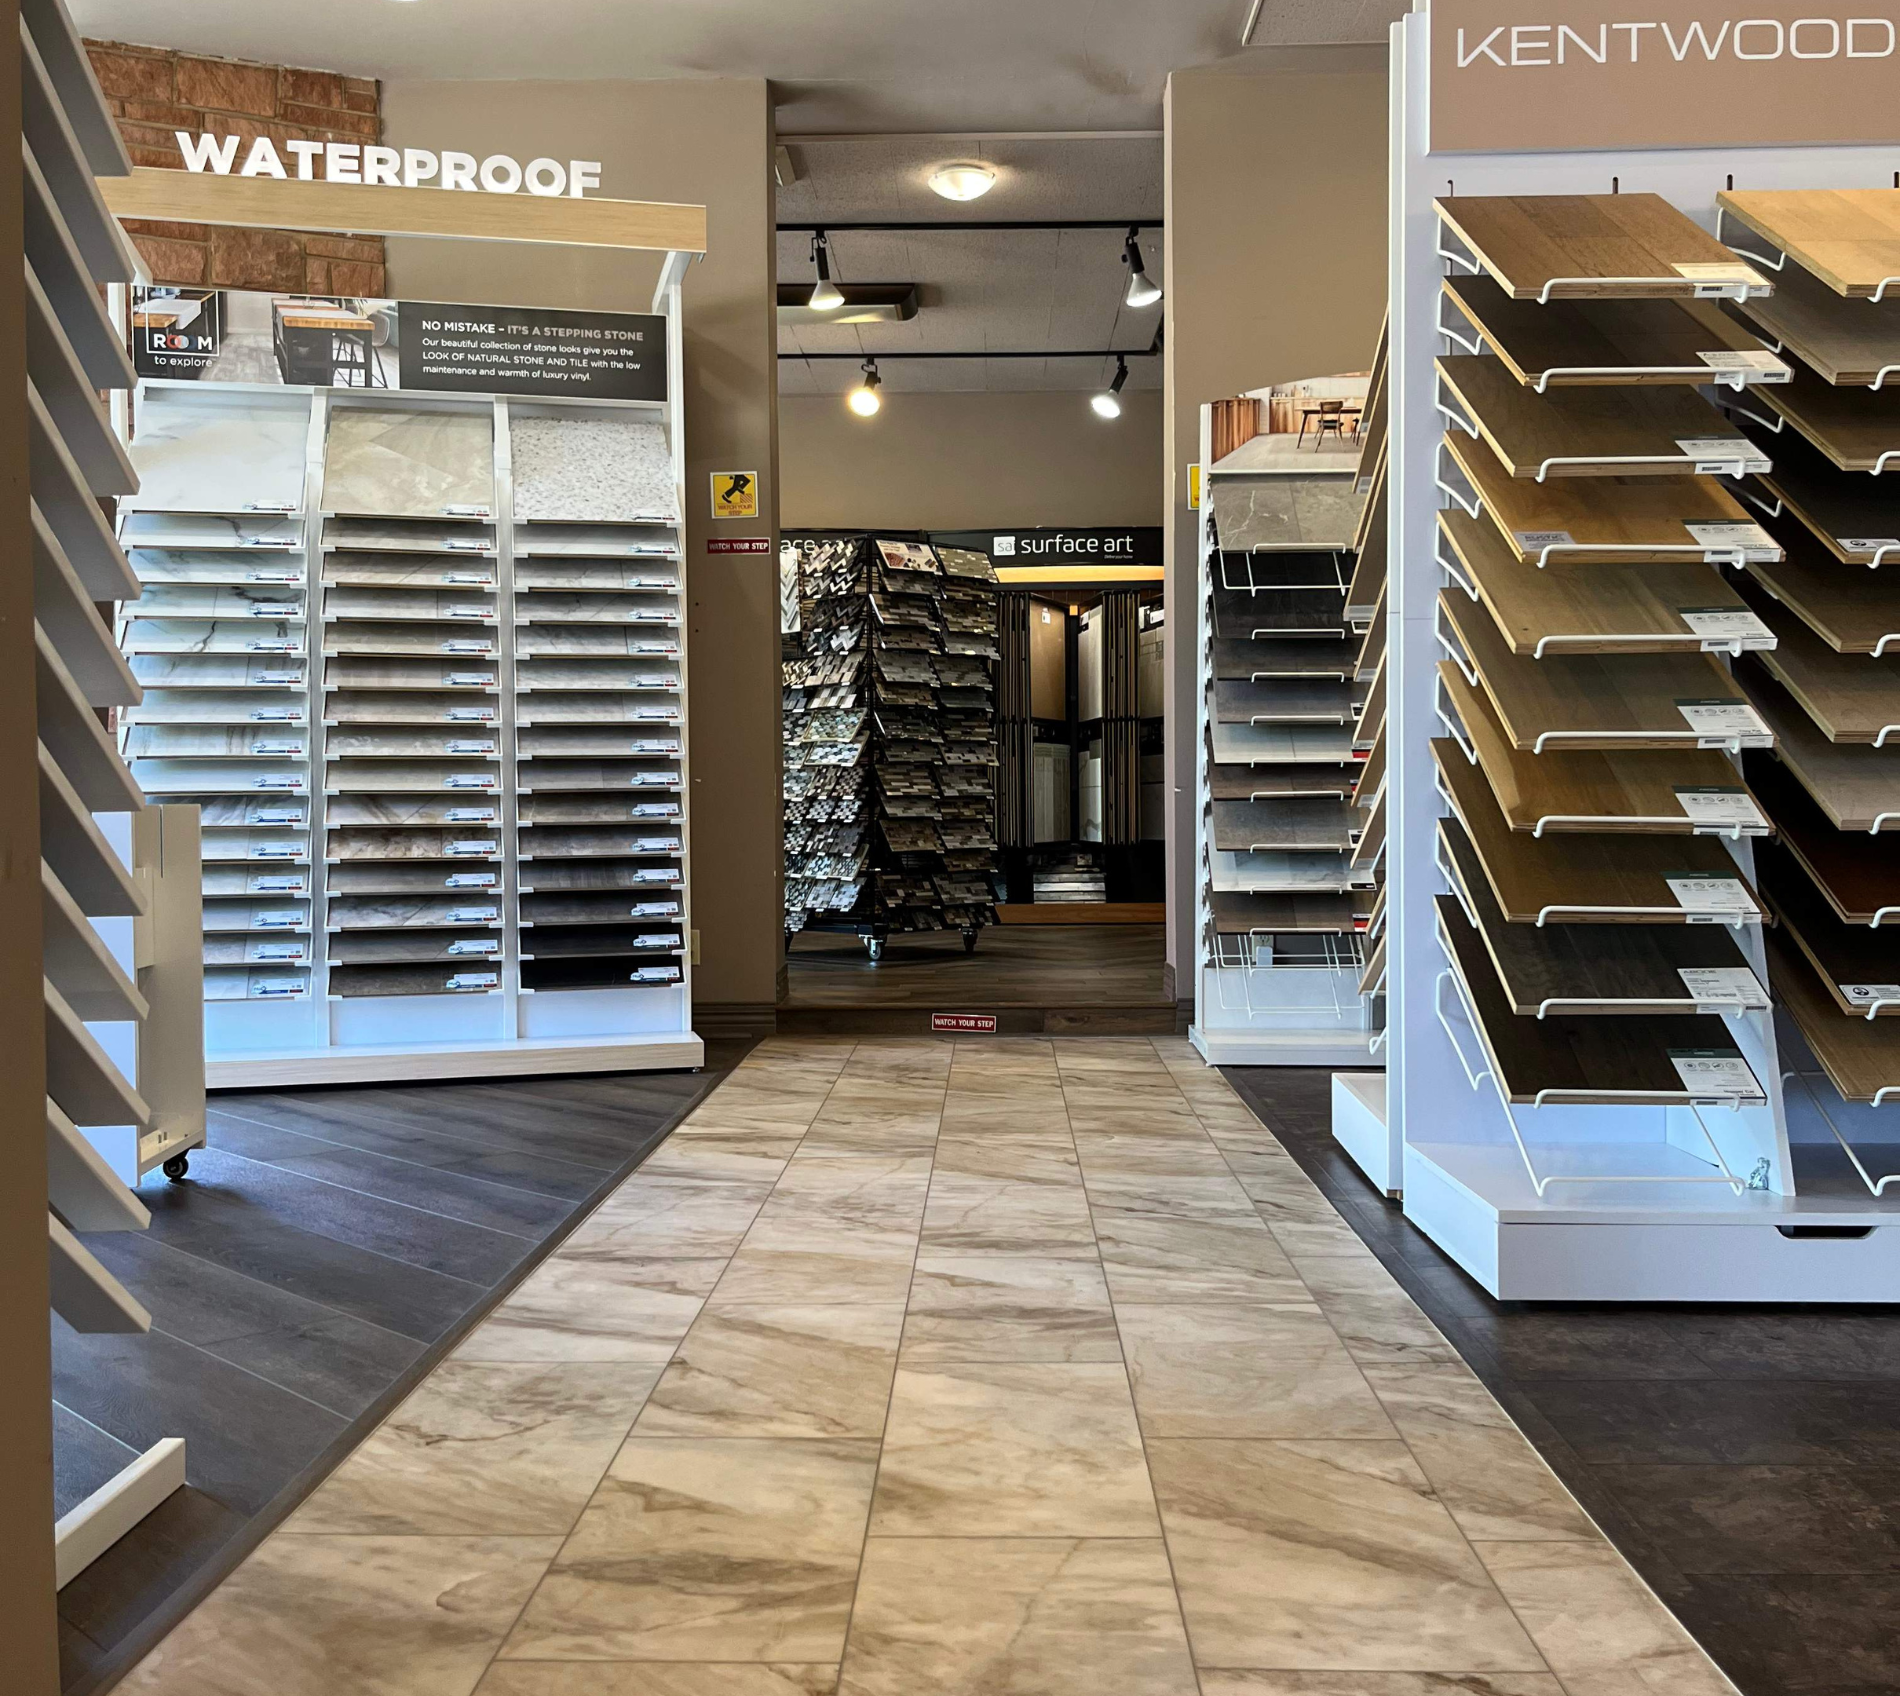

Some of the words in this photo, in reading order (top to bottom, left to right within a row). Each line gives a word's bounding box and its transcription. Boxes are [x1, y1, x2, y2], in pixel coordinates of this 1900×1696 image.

[1457, 18, 1895, 67] KENTWOOD
[175, 131, 602, 198] WATERPROOF
[423, 320, 441, 331] NO
[445, 322, 495, 334] MISTAKE
[532, 326, 541, 336] A
[544, 327, 601, 339] STEPPING
[604, 330, 643, 341] STONE
[153, 334, 212, 350] ROOM
[423, 338, 439, 346] Our
[441, 339, 478, 348] beautiful
[480, 341, 520, 350] collection
[523, 342, 532, 351] of
[534, 344, 556, 352] stone
[559, 344, 581, 353] looks
[583, 346, 600, 356] give
[603, 348, 617, 356] you
[620, 347, 633, 356] the
[154, 356, 166, 365] to
[170, 357, 212, 367] explore
[423, 352, 449, 360] LOOK
[452, 353, 465, 361] OF
[468, 354, 510, 363] NATURAL
[514, 356, 544, 365] STONE
[547, 357, 567, 366] AND
[570, 358, 588, 367] TILE
[591, 360, 608, 368] with
[610, 360, 623, 369] the
[626, 361, 640, 370] low
[423, 365, 477, 375] maintenance
[479, 367, 495, 376] and
[498, 368, 529, 378] warmth
[532, 370, 540, 378] of
[543, 370, 568, 381] luxury
[570, 372, 591, 381] vinyl.
[1021, 534, 1098, 553] surface
[1104, 536, 1133, 552] art
[959, 1019, 975, 1027] YOUR
